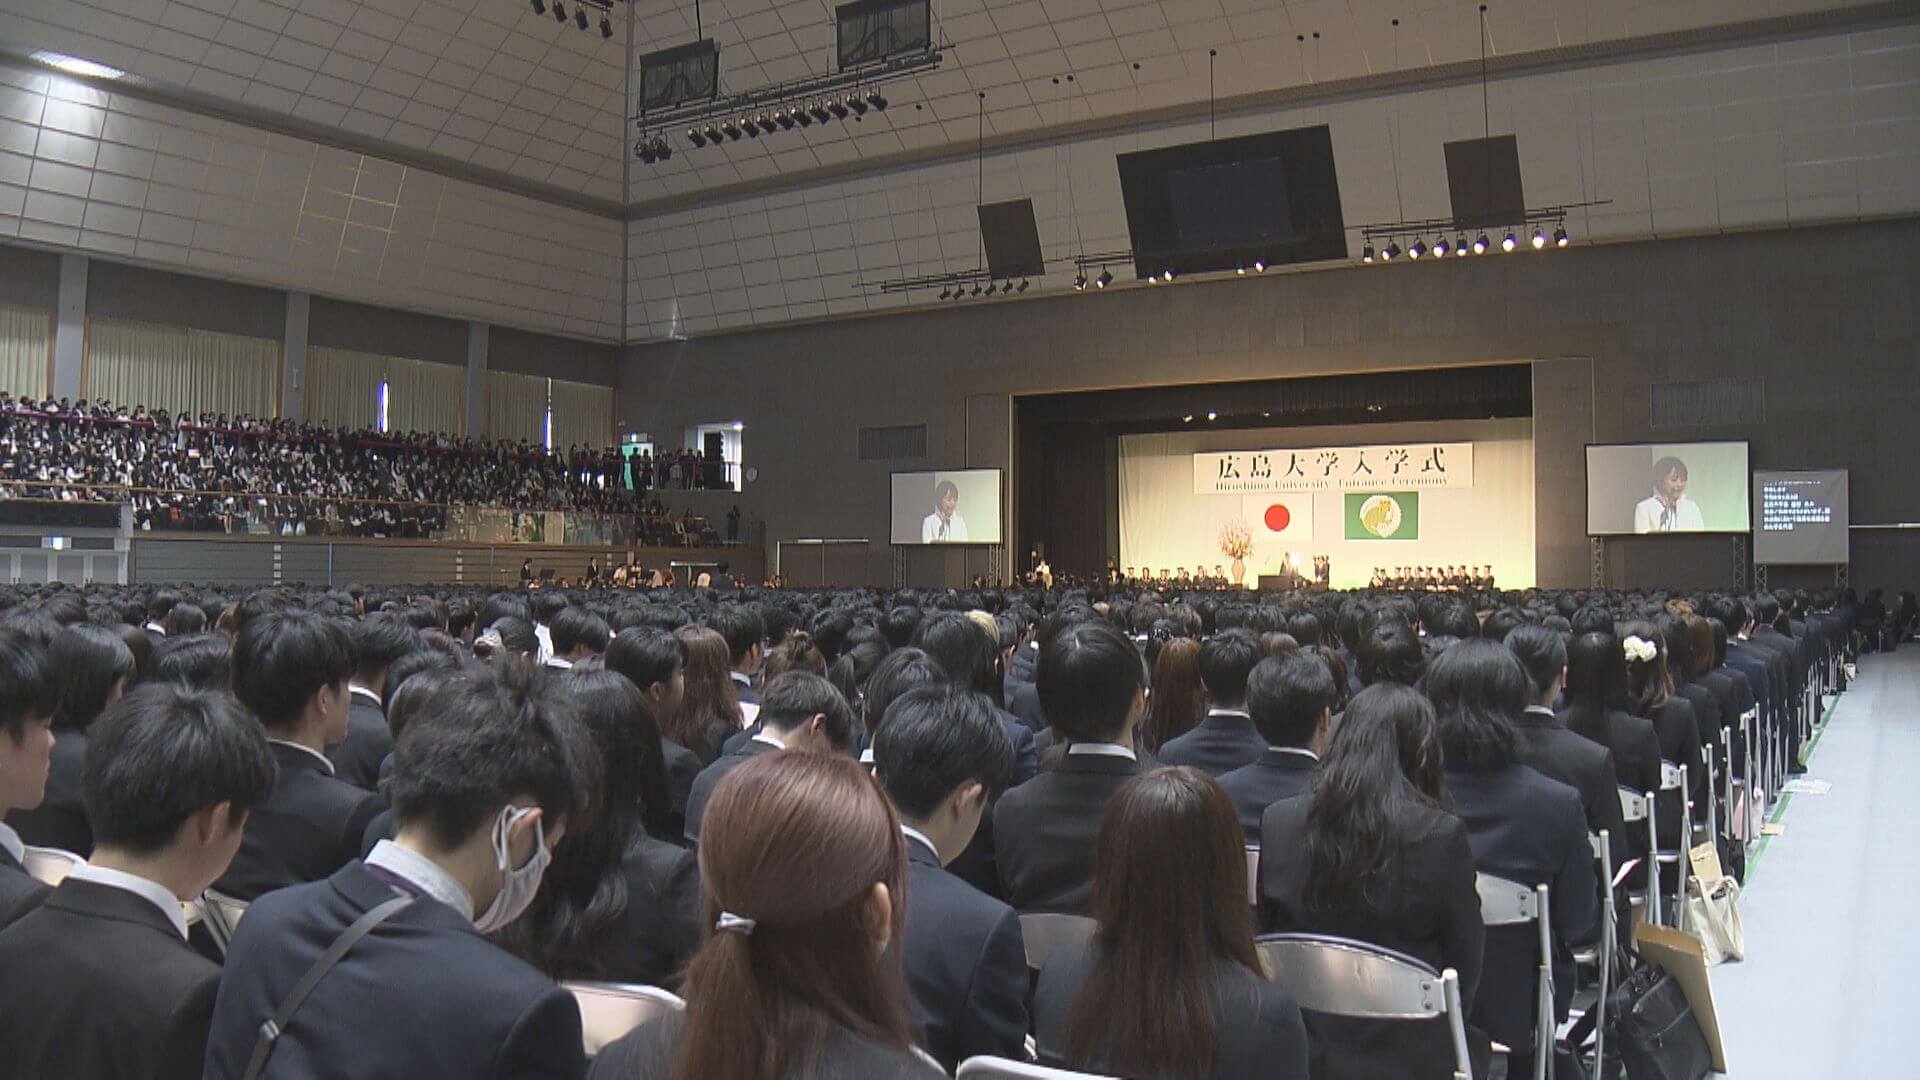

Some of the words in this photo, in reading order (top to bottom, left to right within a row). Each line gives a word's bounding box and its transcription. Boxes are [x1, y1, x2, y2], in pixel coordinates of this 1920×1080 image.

[1218, 447, 1446, 479] 広島大学入学式
[1215, 481, 1269, 491] Hiroshima
[1275, 479, 1329, 489] University
[1392, 476, 1448, 486] Ceremony
